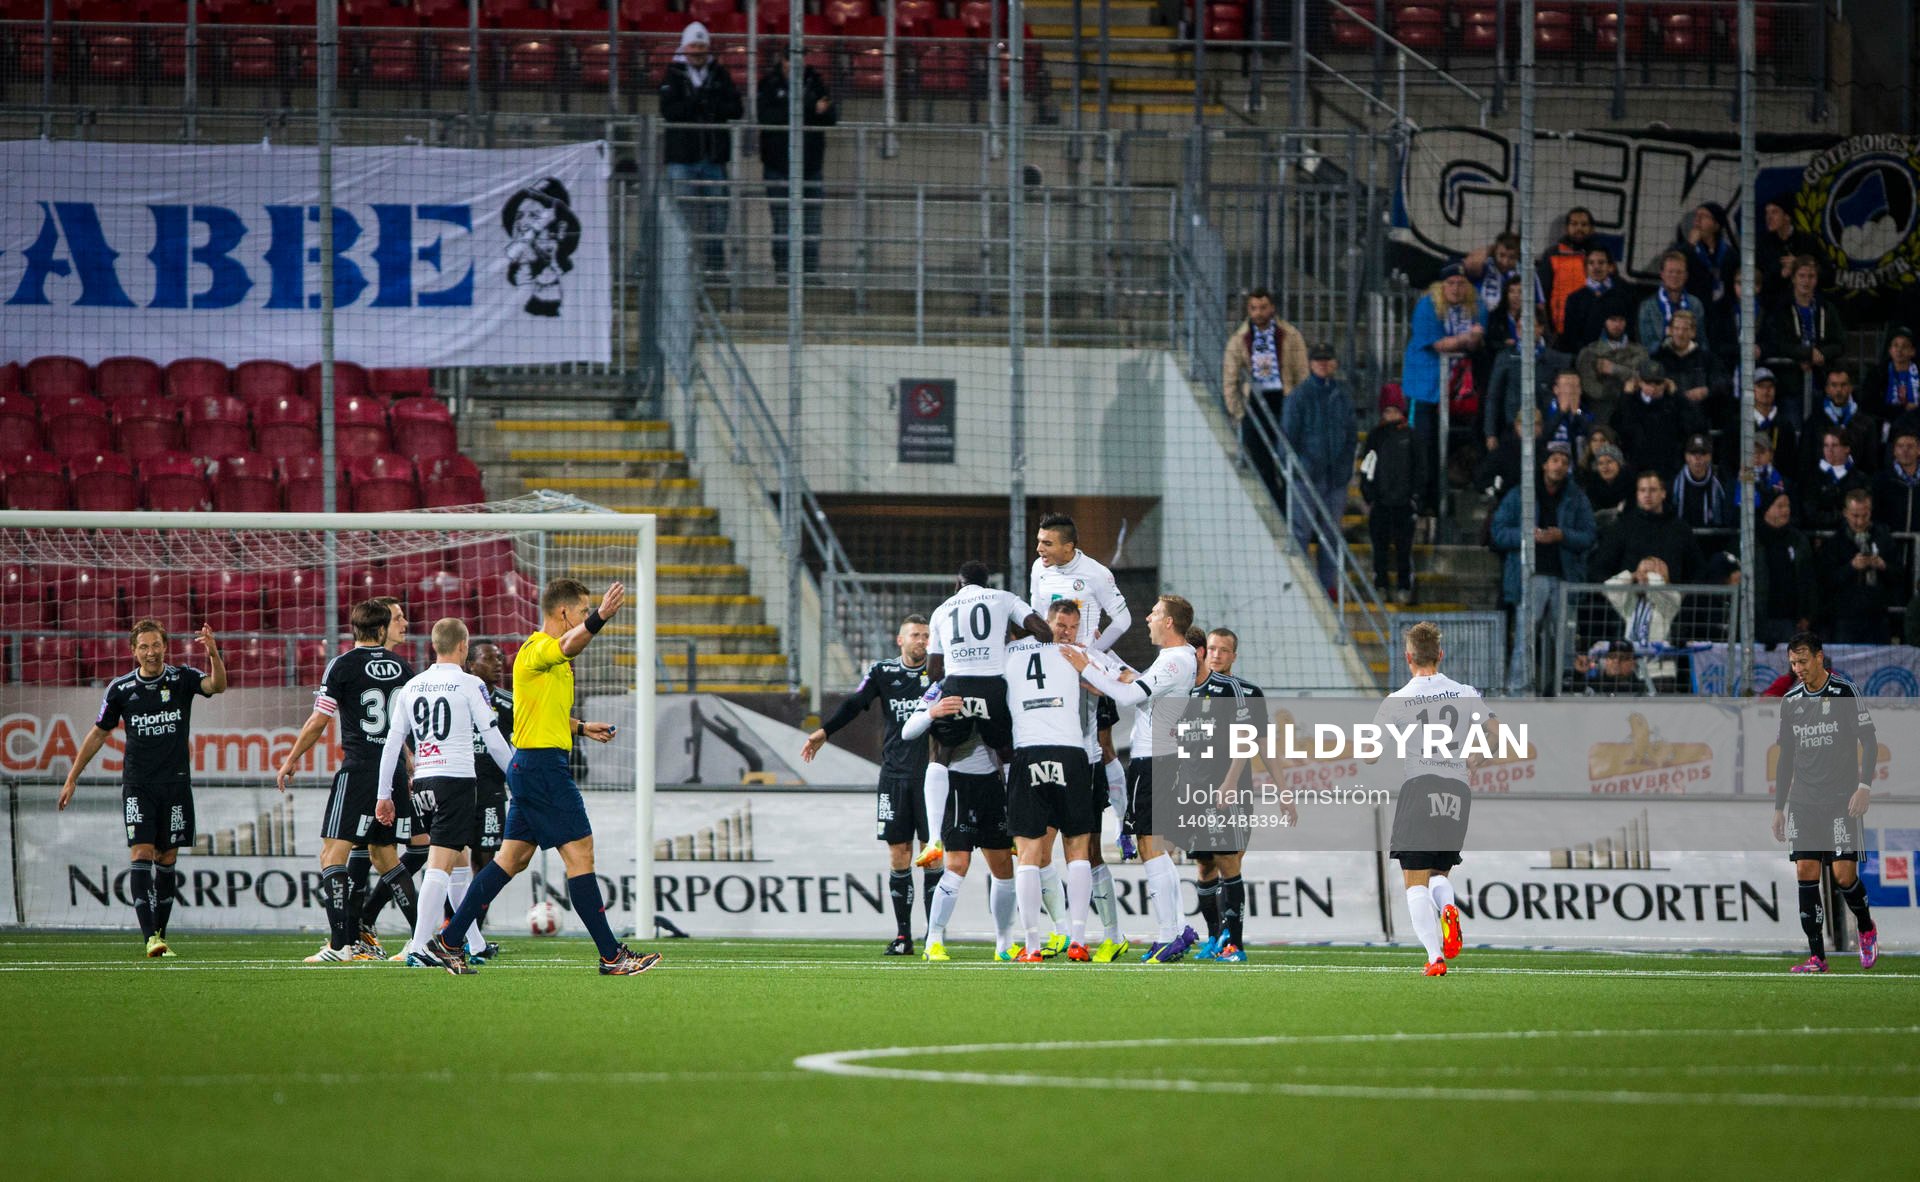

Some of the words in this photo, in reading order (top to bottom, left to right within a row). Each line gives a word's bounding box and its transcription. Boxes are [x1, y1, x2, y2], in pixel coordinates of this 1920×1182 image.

[0, 201, 473, 309] ABBE
[948, 603, 991, 645] 10
[951, 646, 990, 659] GÖRTZ
[370, 663, 398, 677] KIA
[1026, 653, 1046, 690] 4
[410, 682, 460, 693] mätcenter
[1405, 690, 1460, 707] mätcenter
[954, 697, 991, 720] NA
[131, 709, 181, 726] Prioritet
[413, 696, 452, 742] 90
[138, 724, 176, 736] Finans
[1793, 721, 1838, 737] Prioritet
[1800, 735, 1833, 748] Finans
[1028, 760, 1067, 787] NA
[126, 797, 138, 806] SE
[1428, 792, 1461, 821] NA
[126, 805, 139, 815] RN
[171, 805, 183, 815] SE
[879, 811, 894, 820] EKE
[126, 814, 144, 823] EKE
[170, 814, 184, 823] RN
[170, 822, 187, 831] EKE
[485, 823, 500, 833] EKE
[170, 834, 177, 844] 6
[481, 837, 495, 846] 26
[1210, 837, 1217, 846] 2
[1835, 833, 1851, 843] EKE
[1836, 846, 1842, 856] 9
[1454, 879, 1780, 922] NORRPORTEN
